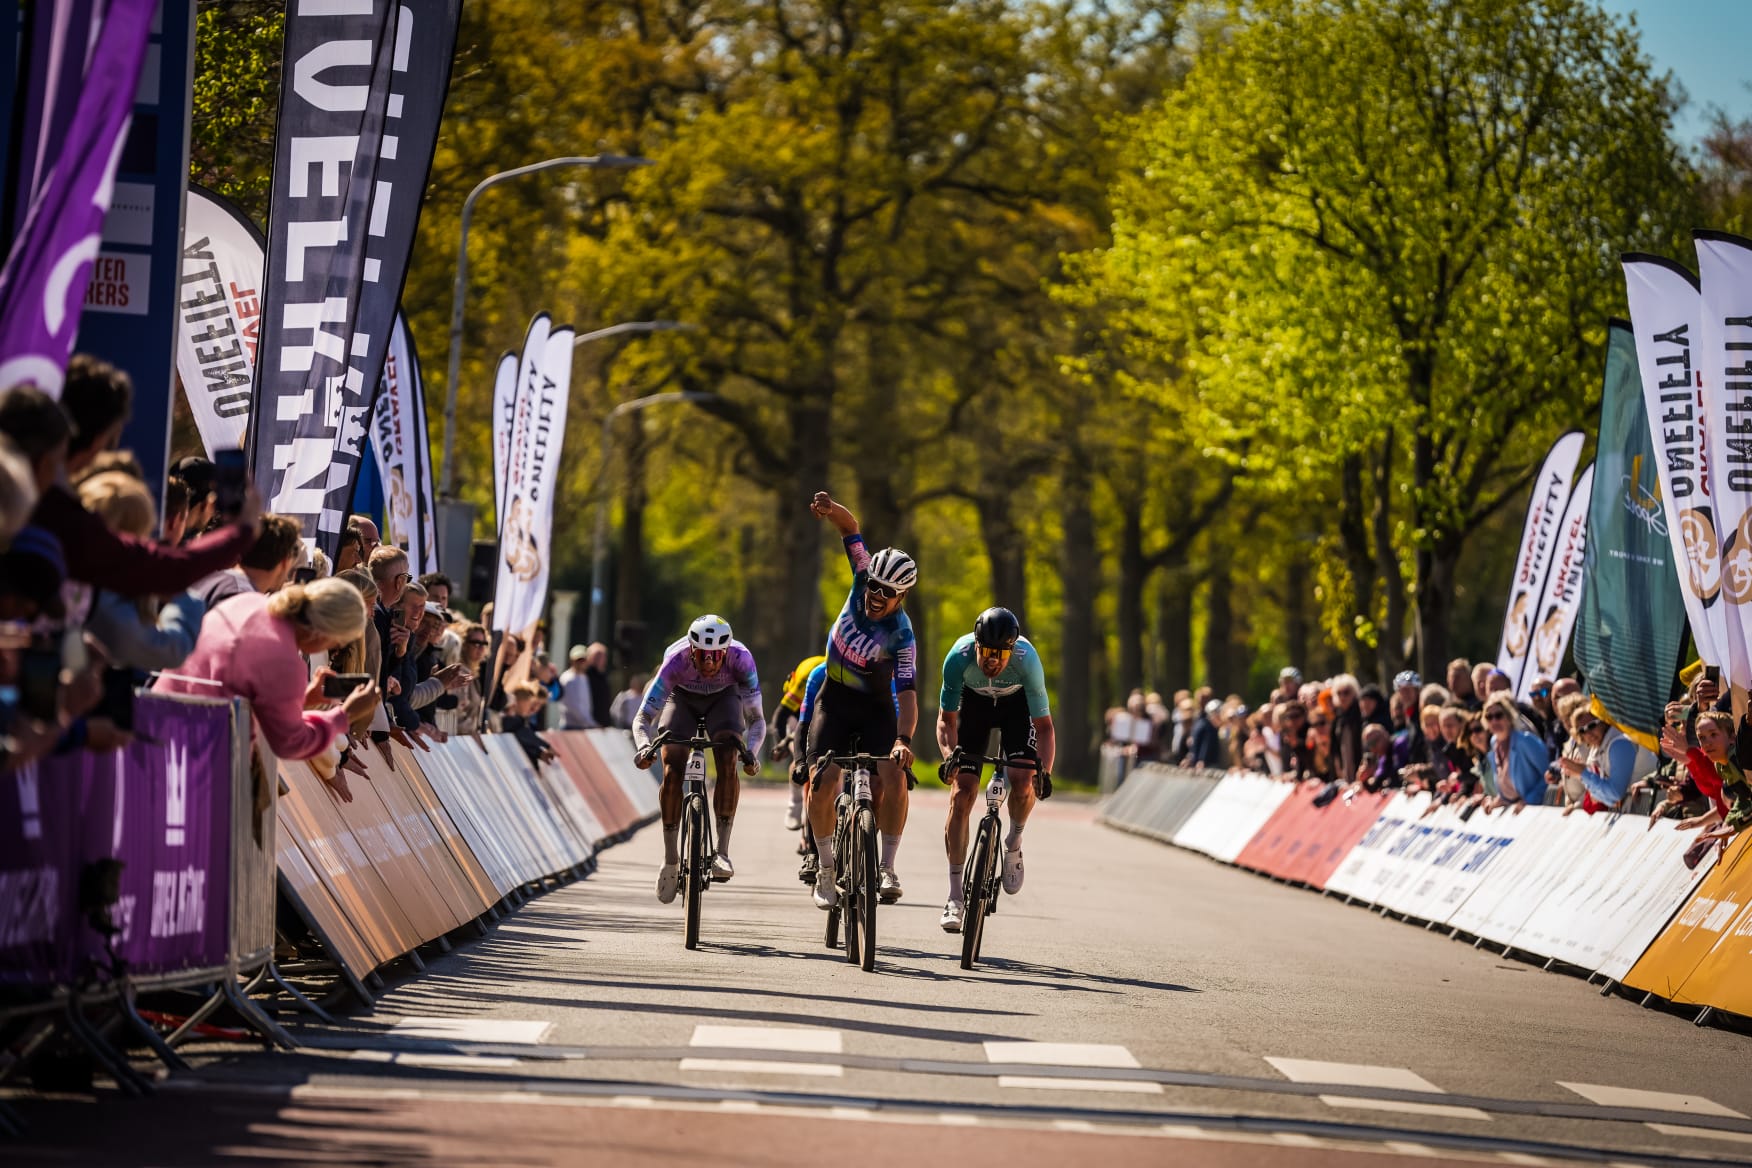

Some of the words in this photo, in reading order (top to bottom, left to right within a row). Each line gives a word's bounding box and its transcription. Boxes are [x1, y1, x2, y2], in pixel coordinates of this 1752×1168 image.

[1552, 513, 1583, 598] GRAVEL
[897, 646, 913, 679] BATAIA
[689, 760, 701, 769] 78
[992, 786, 1003, 796] 81
